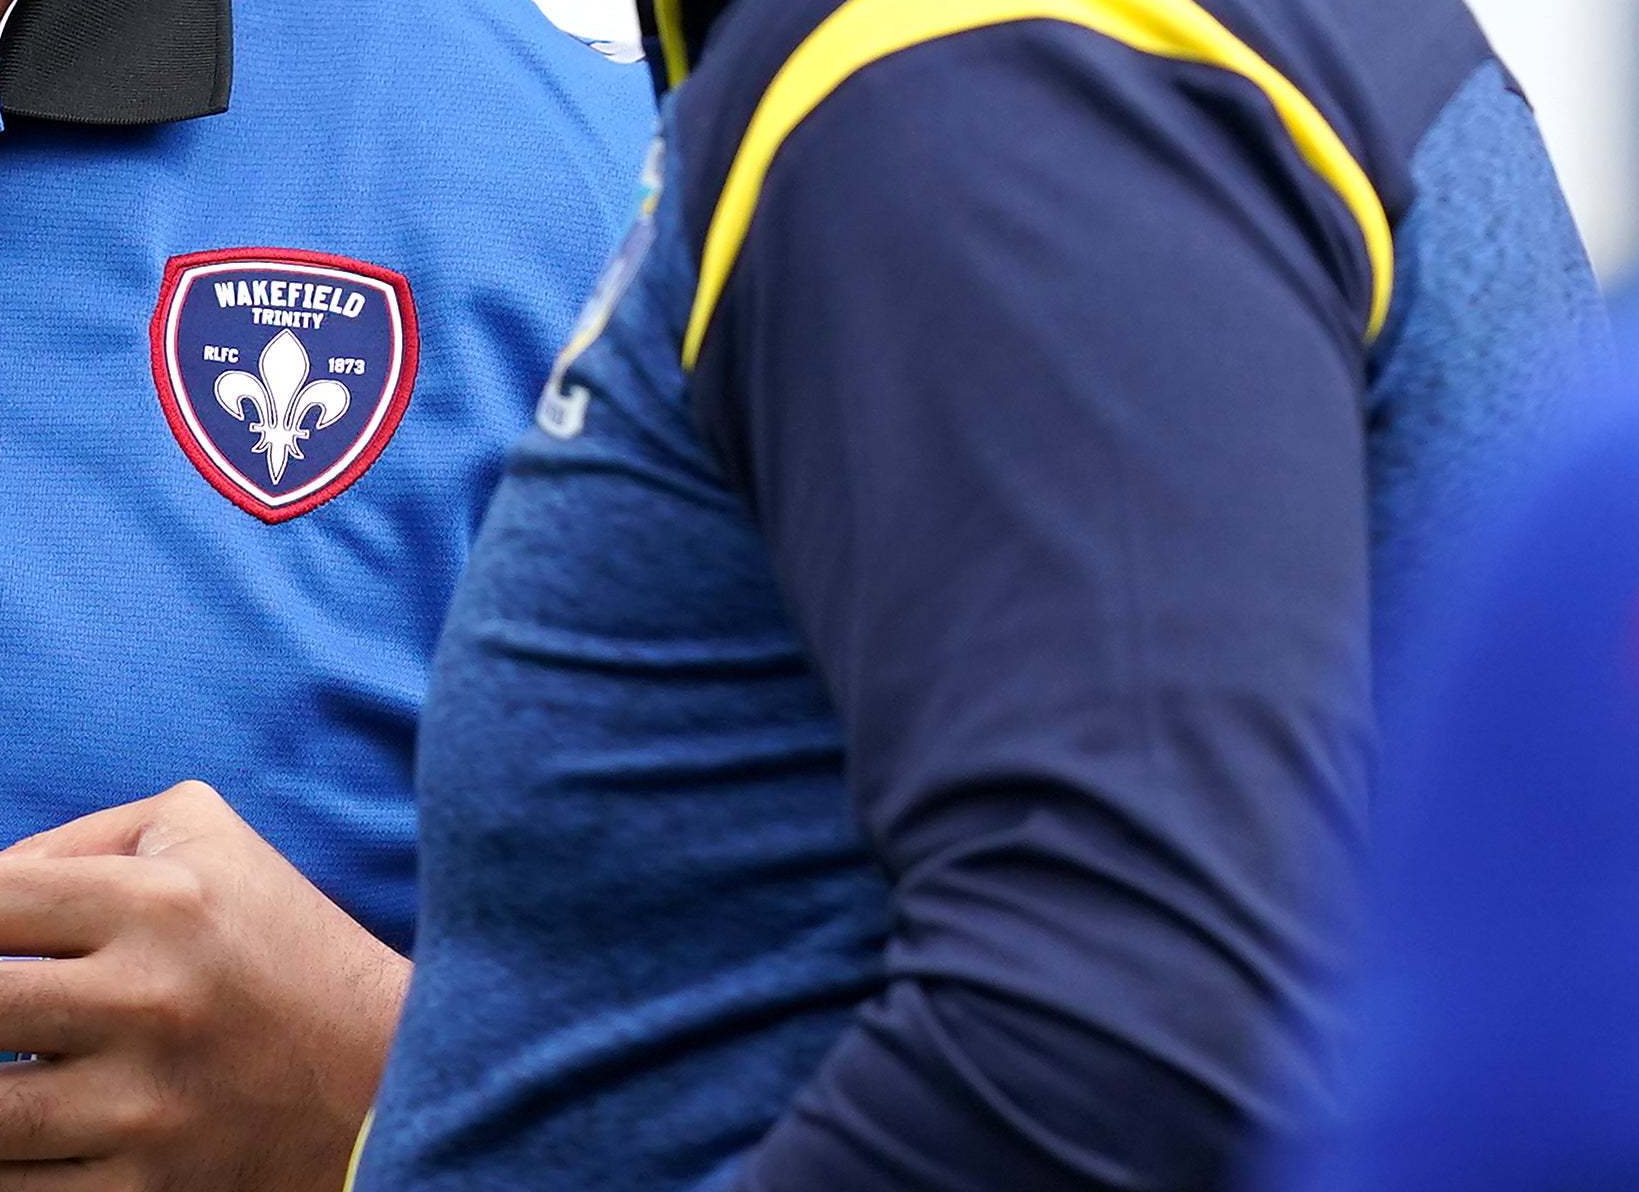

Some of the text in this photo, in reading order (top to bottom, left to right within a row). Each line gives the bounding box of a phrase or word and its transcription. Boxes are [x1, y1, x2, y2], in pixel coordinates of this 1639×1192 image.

[214, 280, 366, 319] WAKEFIELD
[252, 307, 325, 330] TRINITY
[203, 345, 240, 364] RLFC
[328, 357, 366, 376] 1873
